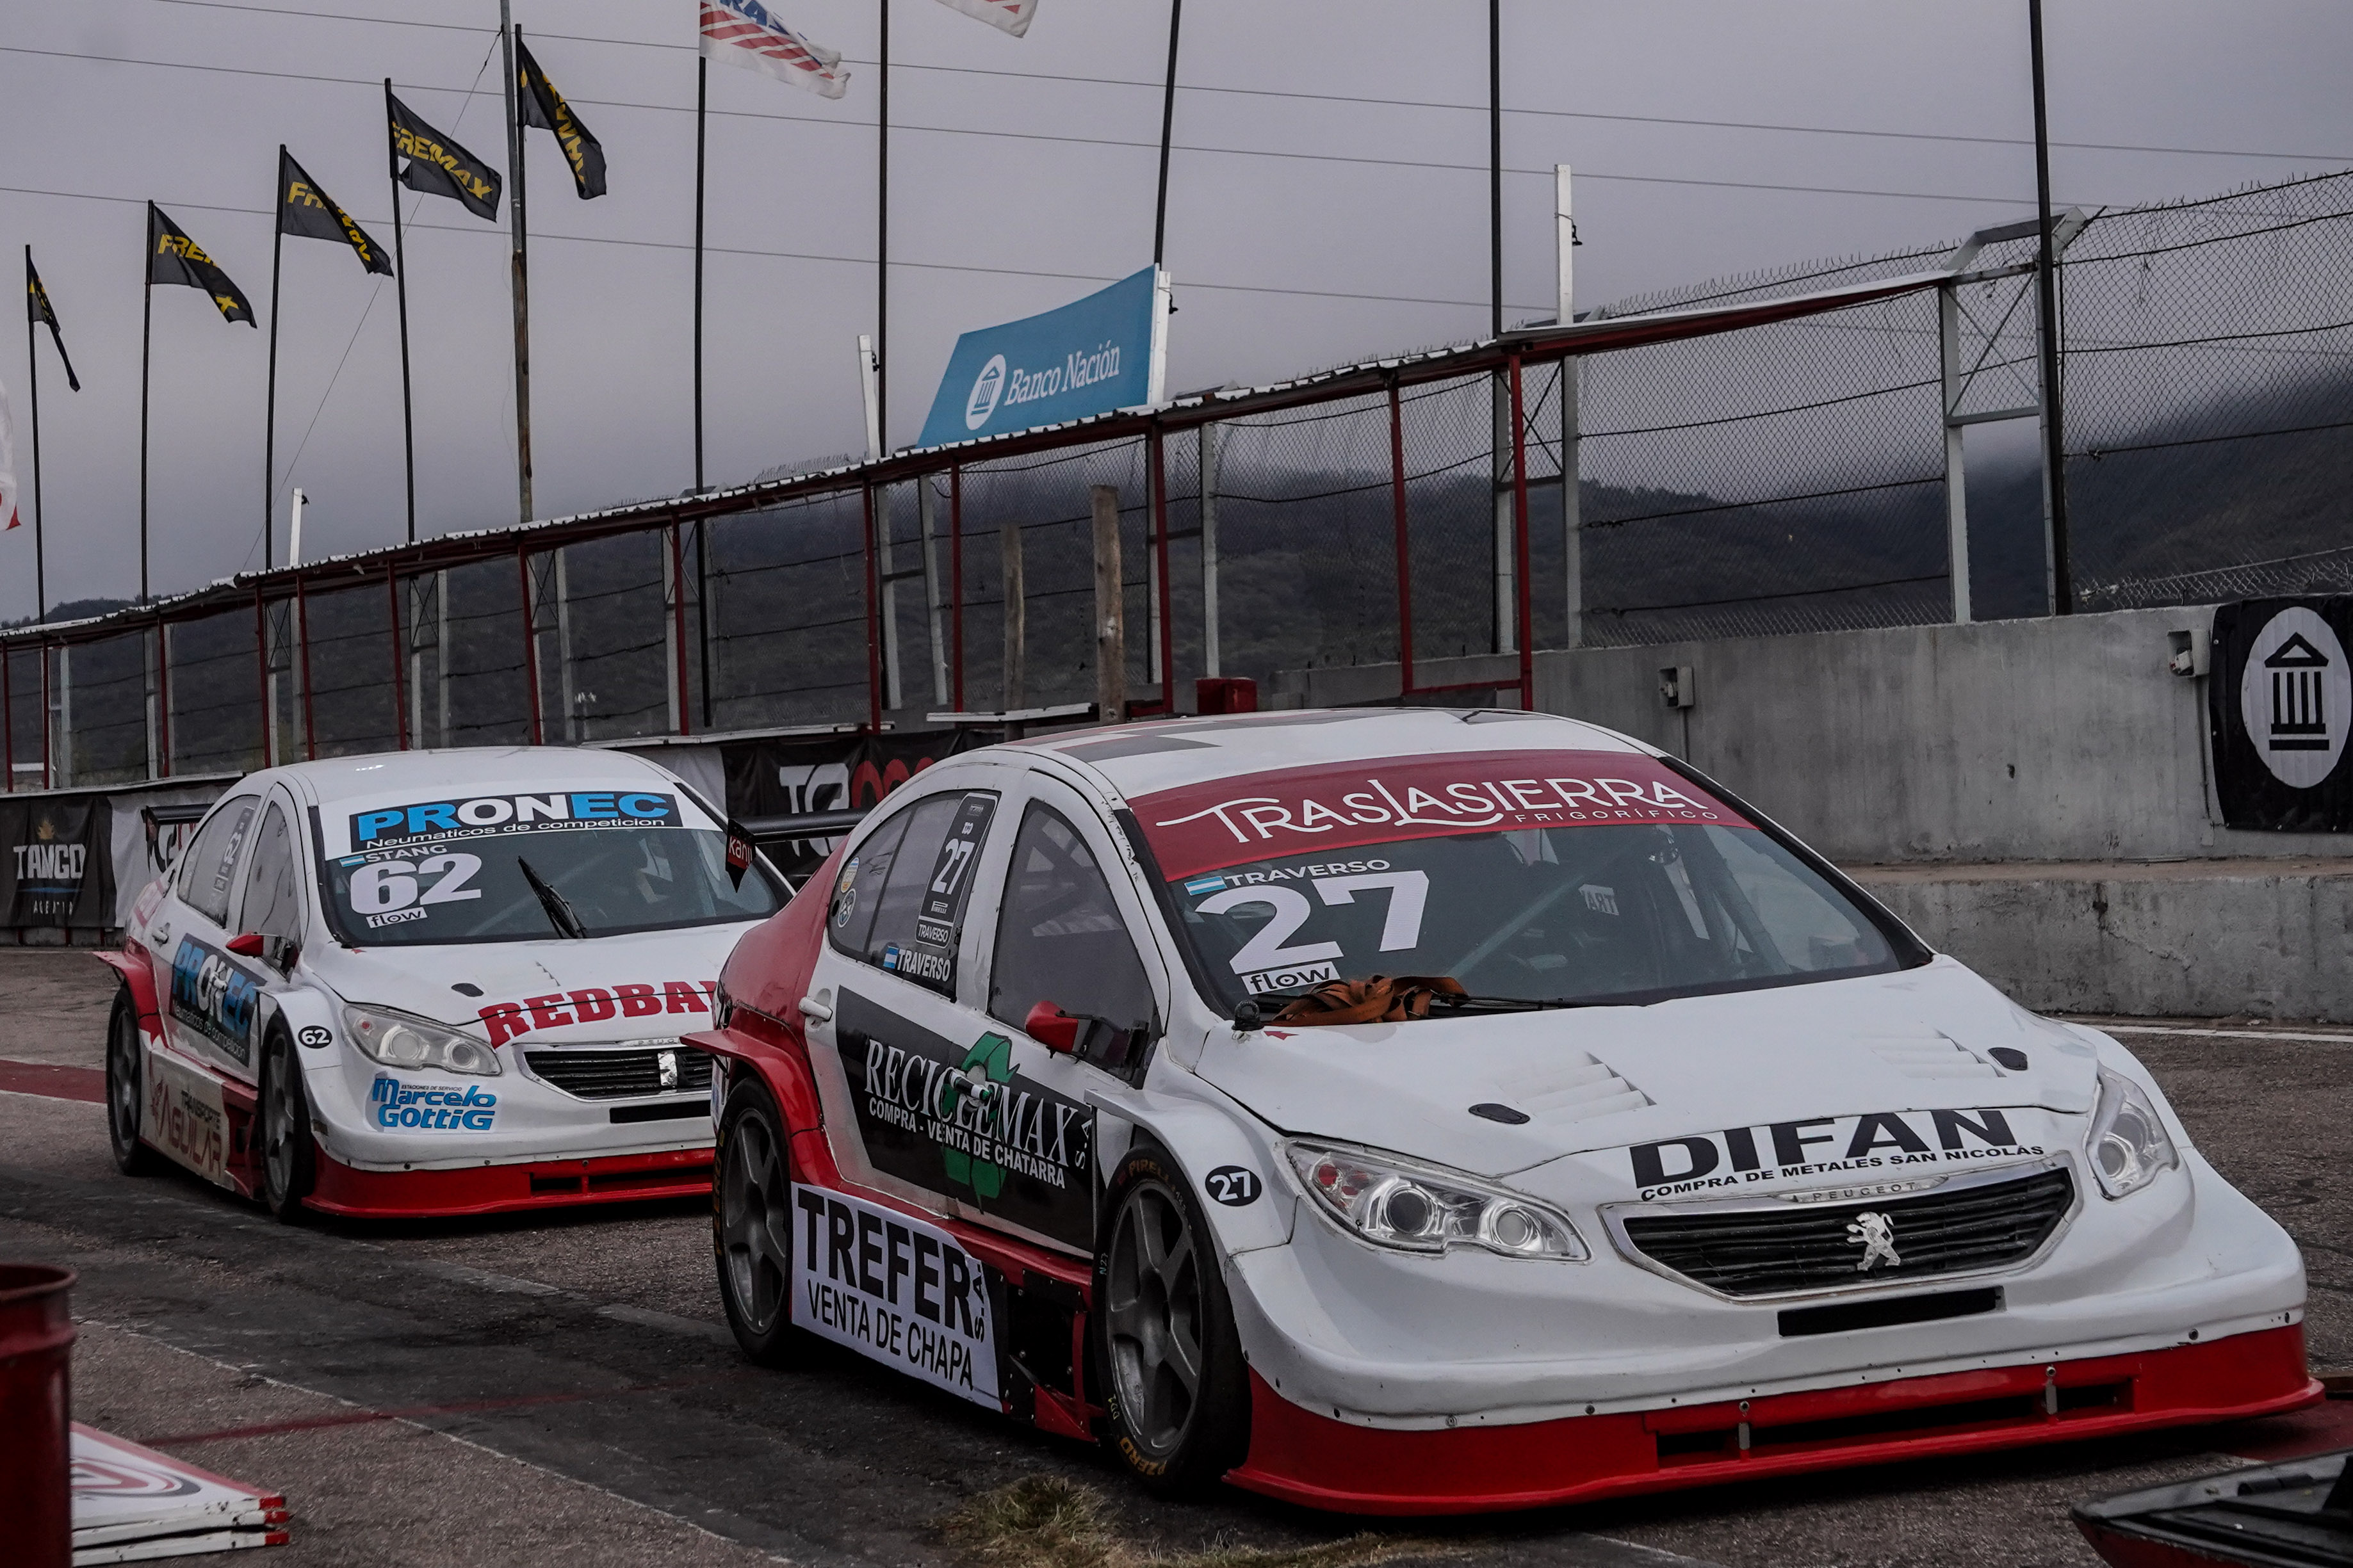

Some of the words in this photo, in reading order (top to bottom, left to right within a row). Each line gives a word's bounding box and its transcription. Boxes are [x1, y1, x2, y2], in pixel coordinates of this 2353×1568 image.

[1005, 367, 1061, 405] Banco
[1061, 340, 1120, 392] Nación
[357, 794, 669, 841] PRONEC
[1155, 778, 1708, 843] TRASLASIERRA
[1515, 809, 1718, 823] FRIGORÍFICO
[367, 827, 496, 849] Neumaticos
[503, 823, 530, 832] de
[538, 818, 664, 829] competicion
[13, 843, 86, 880] TANGO
[365, 845, 448, 862] STANG
[931, 837, 975, 895] 27
[350, 853, 482, 914] 62
[1225, 859, 1390, 887] TRAVERSO
[371, 910, 421, 926] flow
[918, 923, 949, 943] TRAVERSO
[1194, 870, 1430, 975] 27
[897, 948, 951, 982] TRAVERSO
[1250, 967, 1330, 992] flow
[302, 1029, 330, 1046] 62
[372, 1079, 496, 1107] Marcelo
[159, 1085, 222, 1177] AGUILAR
[869, 1097, 916, 1133] COMPRA
[927, 1119, 970, 1152] VENTA
[973, 1137, 990, 1161] DE
[995, 1144, 1065, 1189] CHATARRA
[1629, 1110, 2017, 1188] DIFAN
[1209, 1171, 1252, 1202] 27
[1641, 1176, 1738, 1201] COMPRA
[1746, 1170, 1774, 1182] DE
[1783, 1157, 1882, 1177] METALES
[1890, 1151, 1937, 1165] SAN
[1945, 1145, 2044, 1161] NICOLÁS
[1812, 1182, 1916, 1201] PEUGEOT
[798, 1188, 974, 1339] TREFER
[808, 1278, 870, 1343] VENTA
[876, 1308, 902, 1356] DE
[908, 1321, 973, 1391] CHAPA
